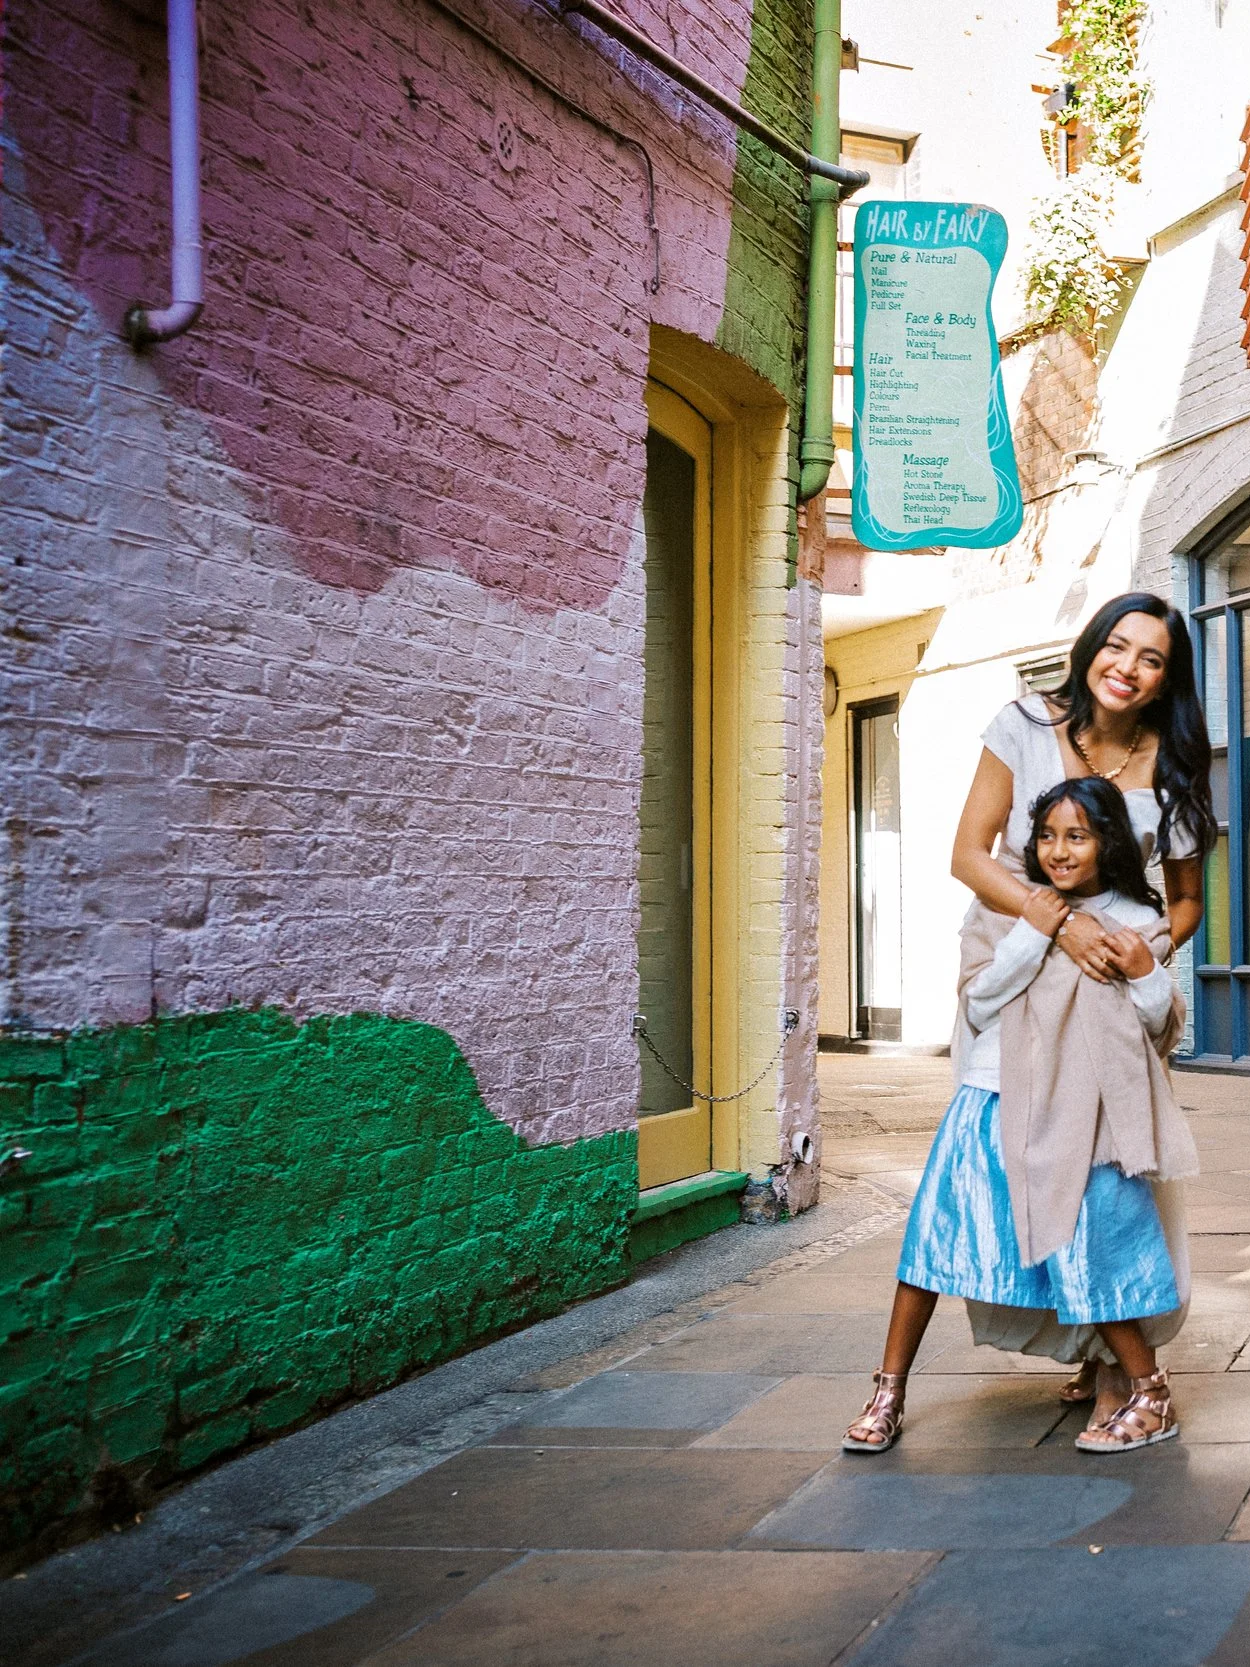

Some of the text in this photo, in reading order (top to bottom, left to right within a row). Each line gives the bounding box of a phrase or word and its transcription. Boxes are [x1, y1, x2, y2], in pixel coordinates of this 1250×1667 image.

[866, 205, 908, 242] HAIR
[870, 251, 957, 264] Pure & Natural
[871, 267, 887, 275] Nail
[871, 278, 908, 287] Manicure
[871, 290, 904, 298] Pedicure
[871, 302, 901, 310] Full Set
[905, 312, 976, 328] Face & Body
[906, 328, 945, 339] Threading
[906, 339, 937, 349] Waxing
[869, 352, 893, 364] Hair
[905, 351, 972, 360] Facial Treatment
[870, 369, 904, 377] Hair Cut
[870, 380, 919, 391] Highlighting
[870, 391, 900, 400] Colours
[869, 403, 890, 411] Perm
[869, 414, 960, 427] Brazilian Straightening
[869, 426, 932, 435] Hair Extensions
[869, 437, 913, 446] Dreadlocks
[903, 454, 949, 469] Massage
[904, 469, 943, 478] Hot Stone
[904, 481, 965, 493] Aroma Therapy
[904, 492, 987, 504] Swedish Deep Tissue
[904, 503, 950, 515] Reflexology
[904, 515, 944, 524] Thai Head
